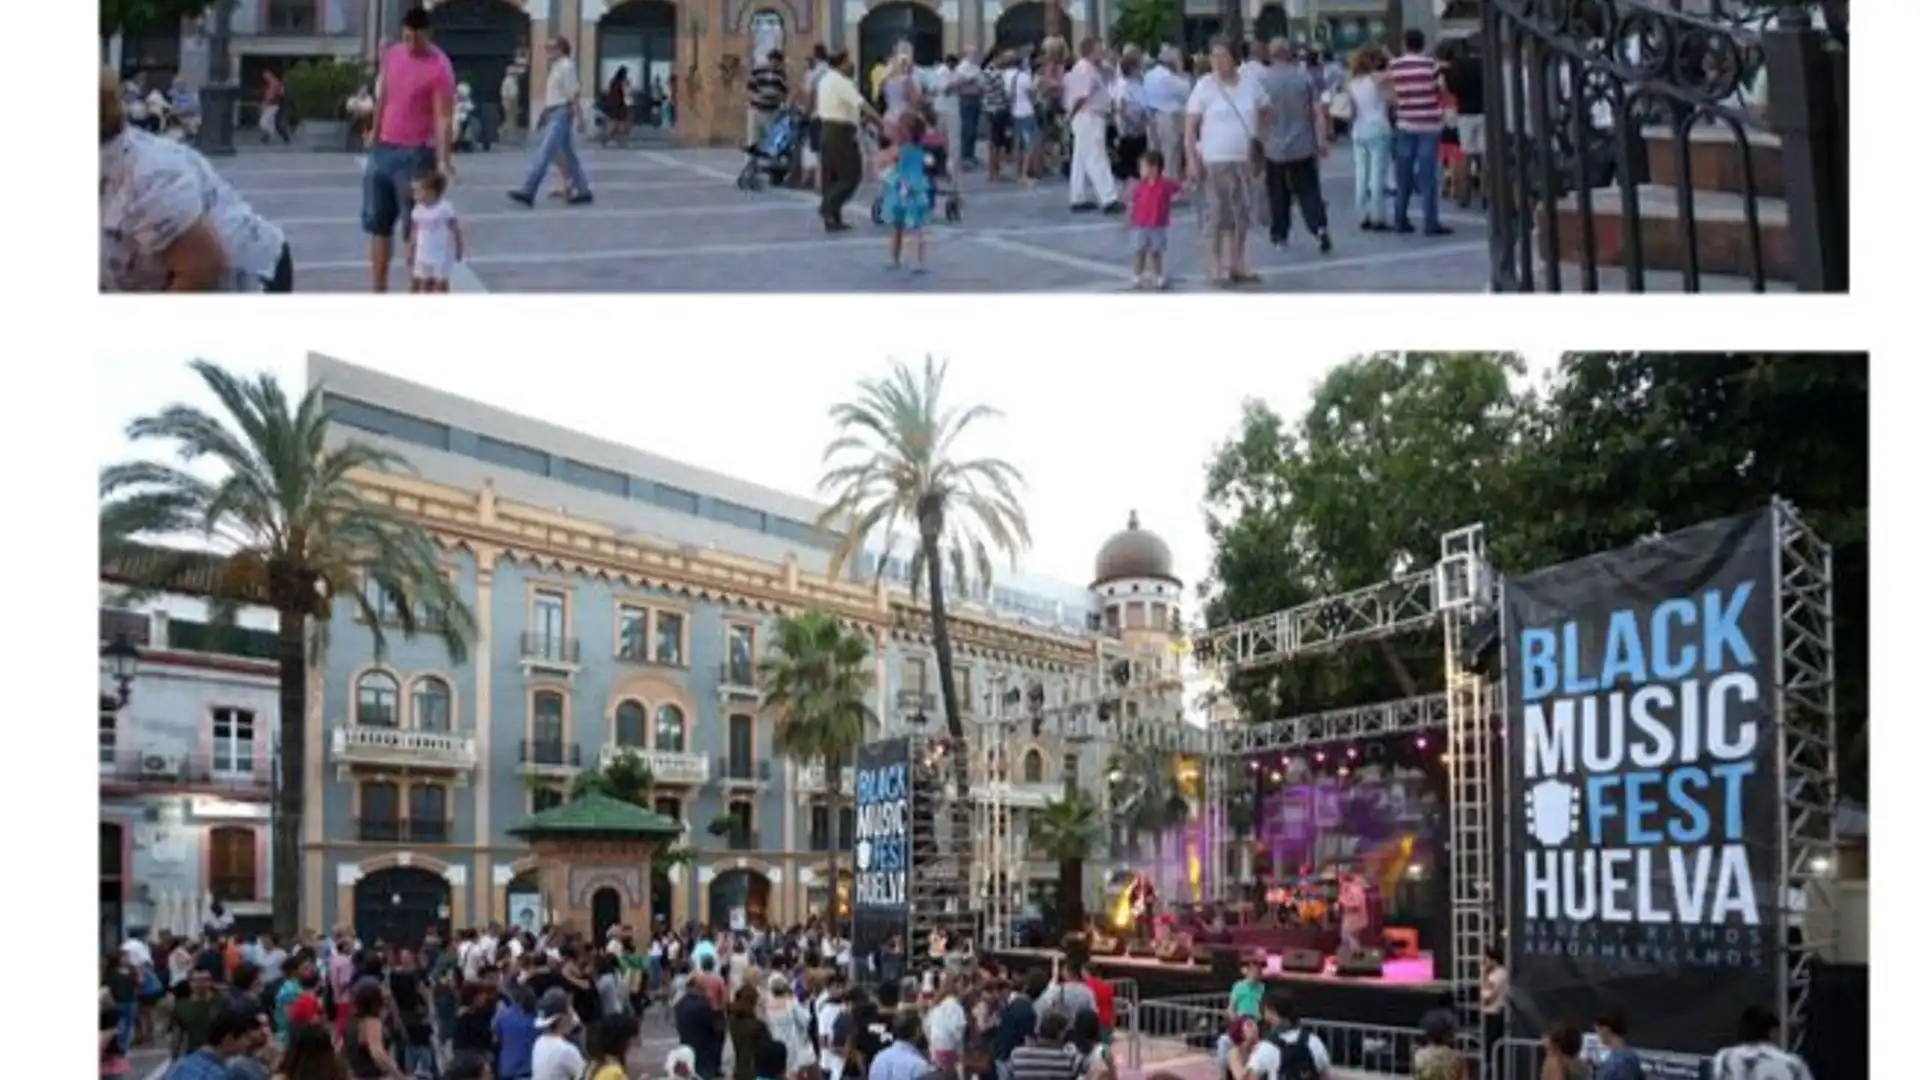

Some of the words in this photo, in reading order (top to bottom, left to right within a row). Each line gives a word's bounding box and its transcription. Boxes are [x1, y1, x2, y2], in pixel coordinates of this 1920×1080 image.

[1520, 580, 1757, 699] BLACK
[1523, 671, 1759, 778] MUSIC
[855, 799, 907, 839] MUSIC
[857, 763, 907, 805] BLACK
[1586, 761, 1756, 845] FEST
[1524, 845, 1760, 925] HUELVA
